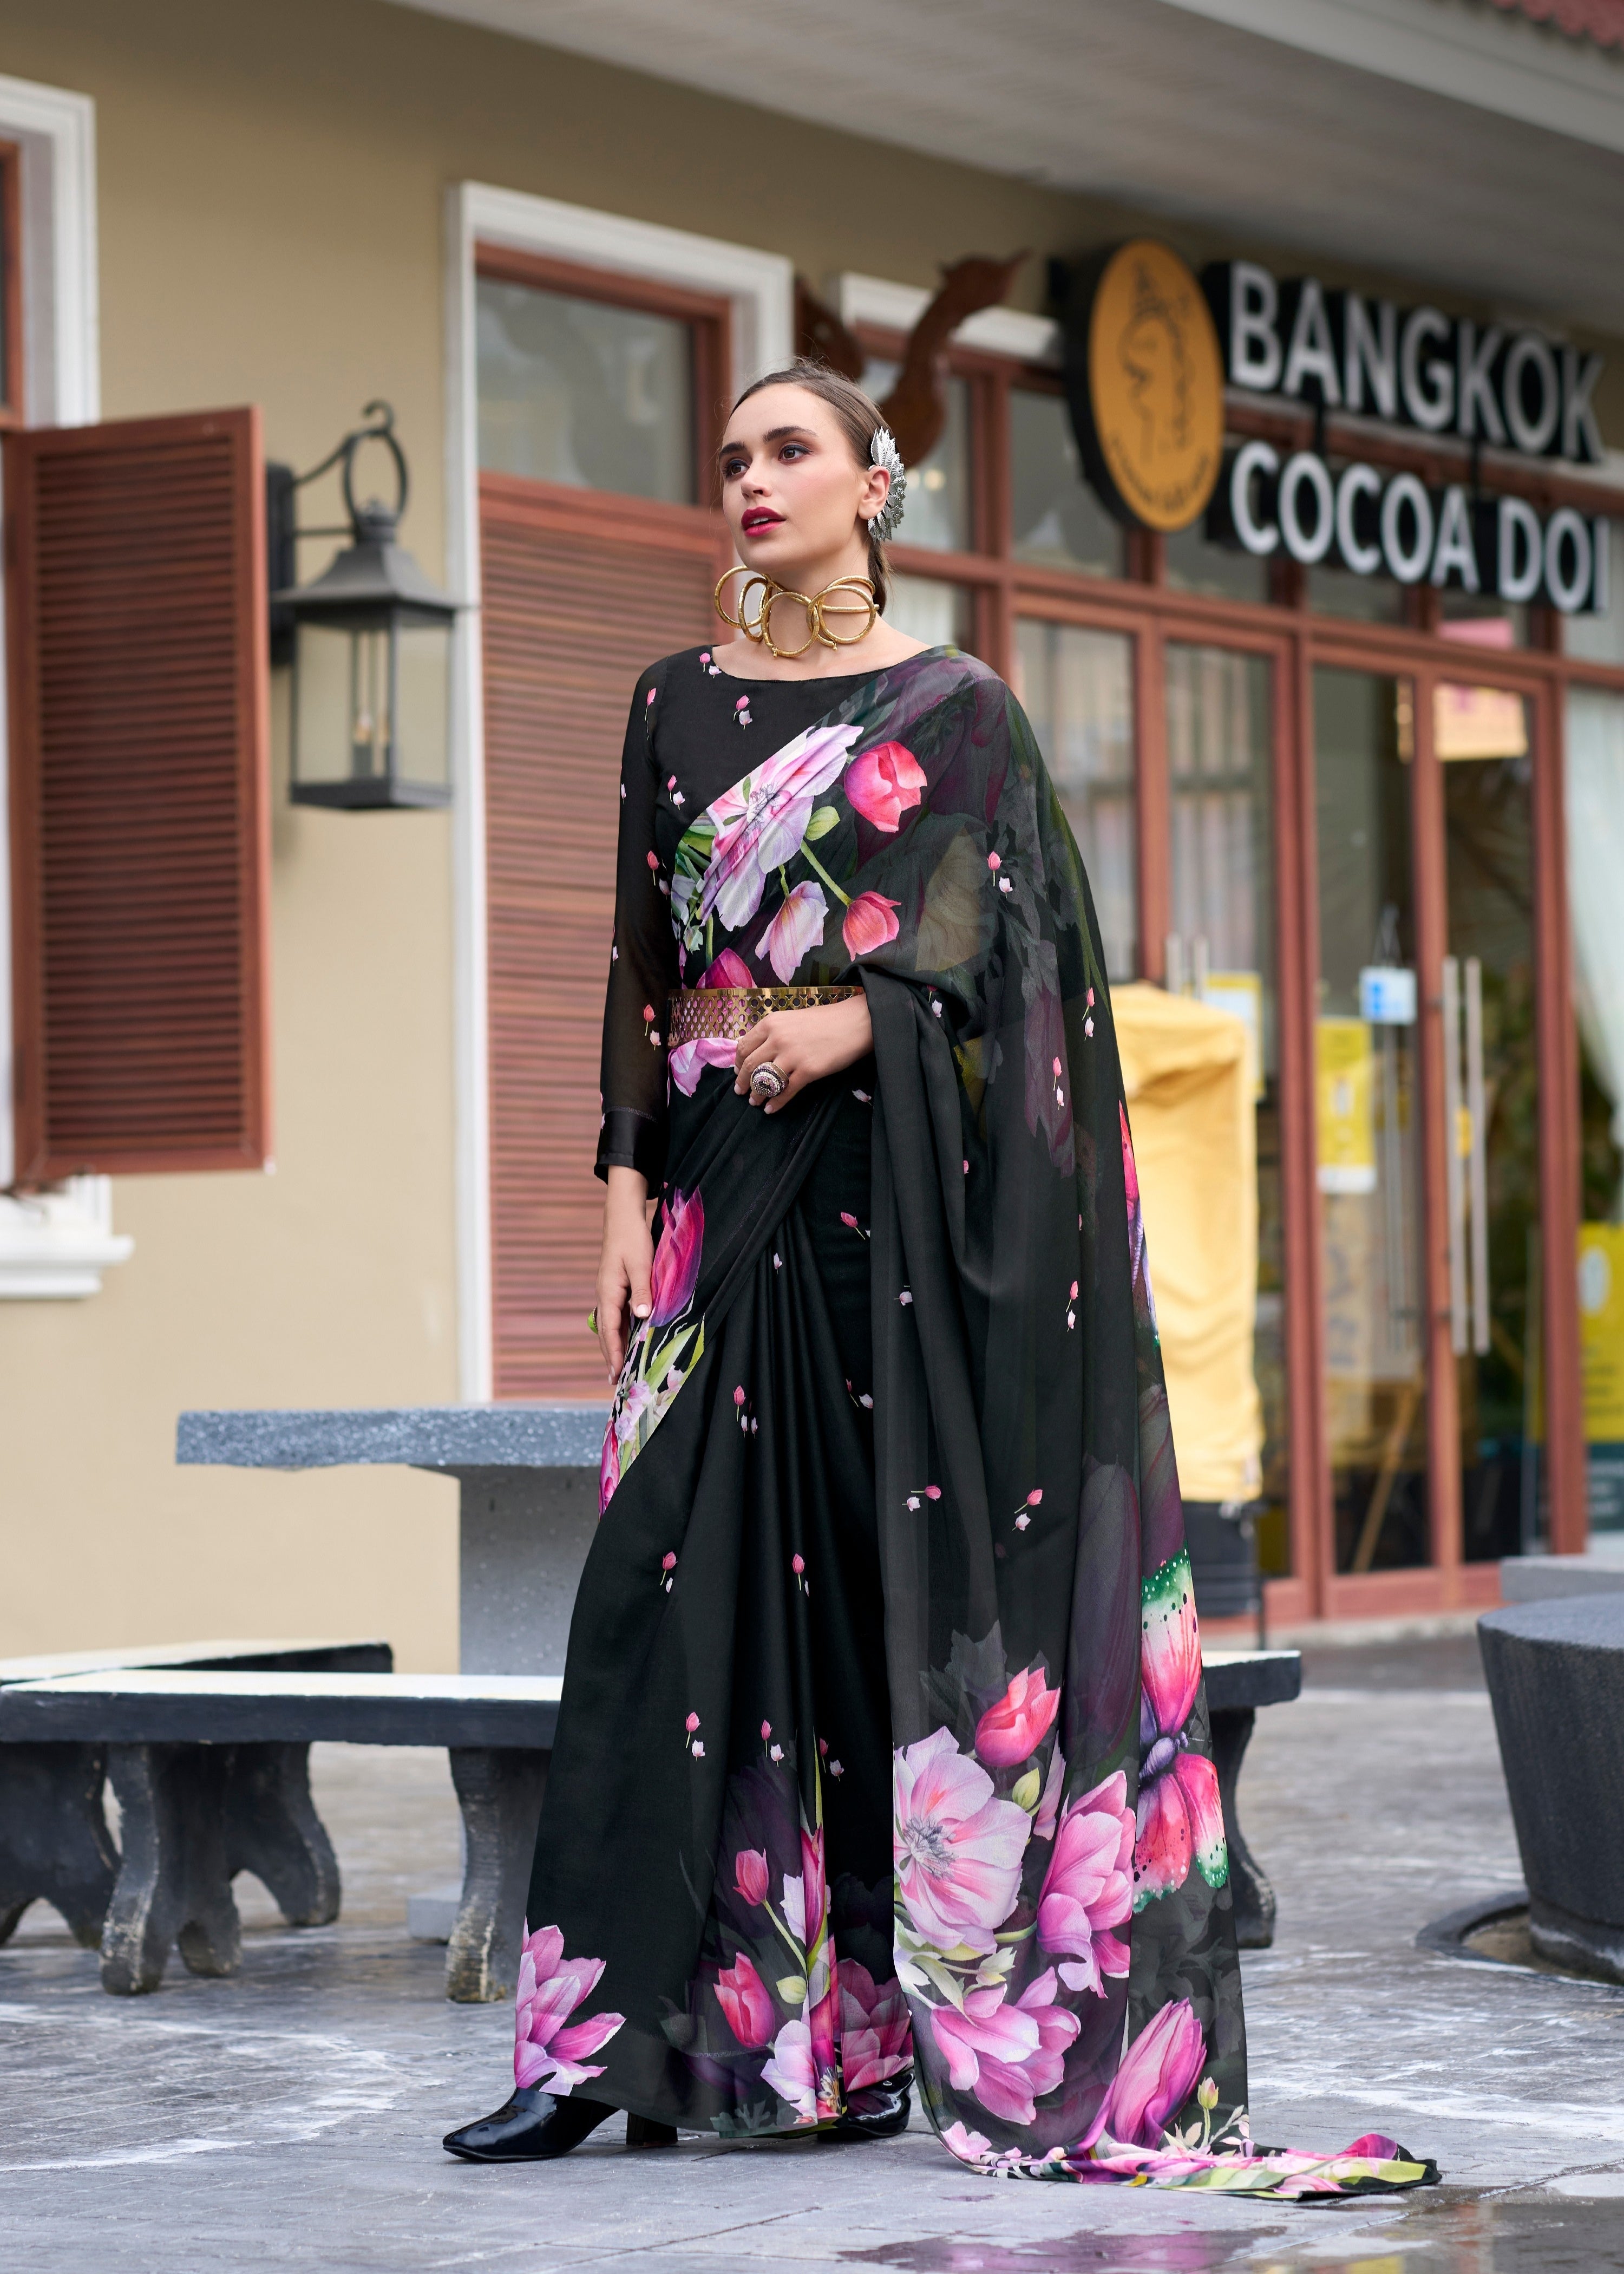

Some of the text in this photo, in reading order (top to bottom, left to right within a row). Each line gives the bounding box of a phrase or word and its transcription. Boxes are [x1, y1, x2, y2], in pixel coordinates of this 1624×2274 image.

[1230, 262, 1603, 462] BANGKOK
[1230, 441, 1480, 593] COCOA
[1498, 495, 1609, 614] DOI
